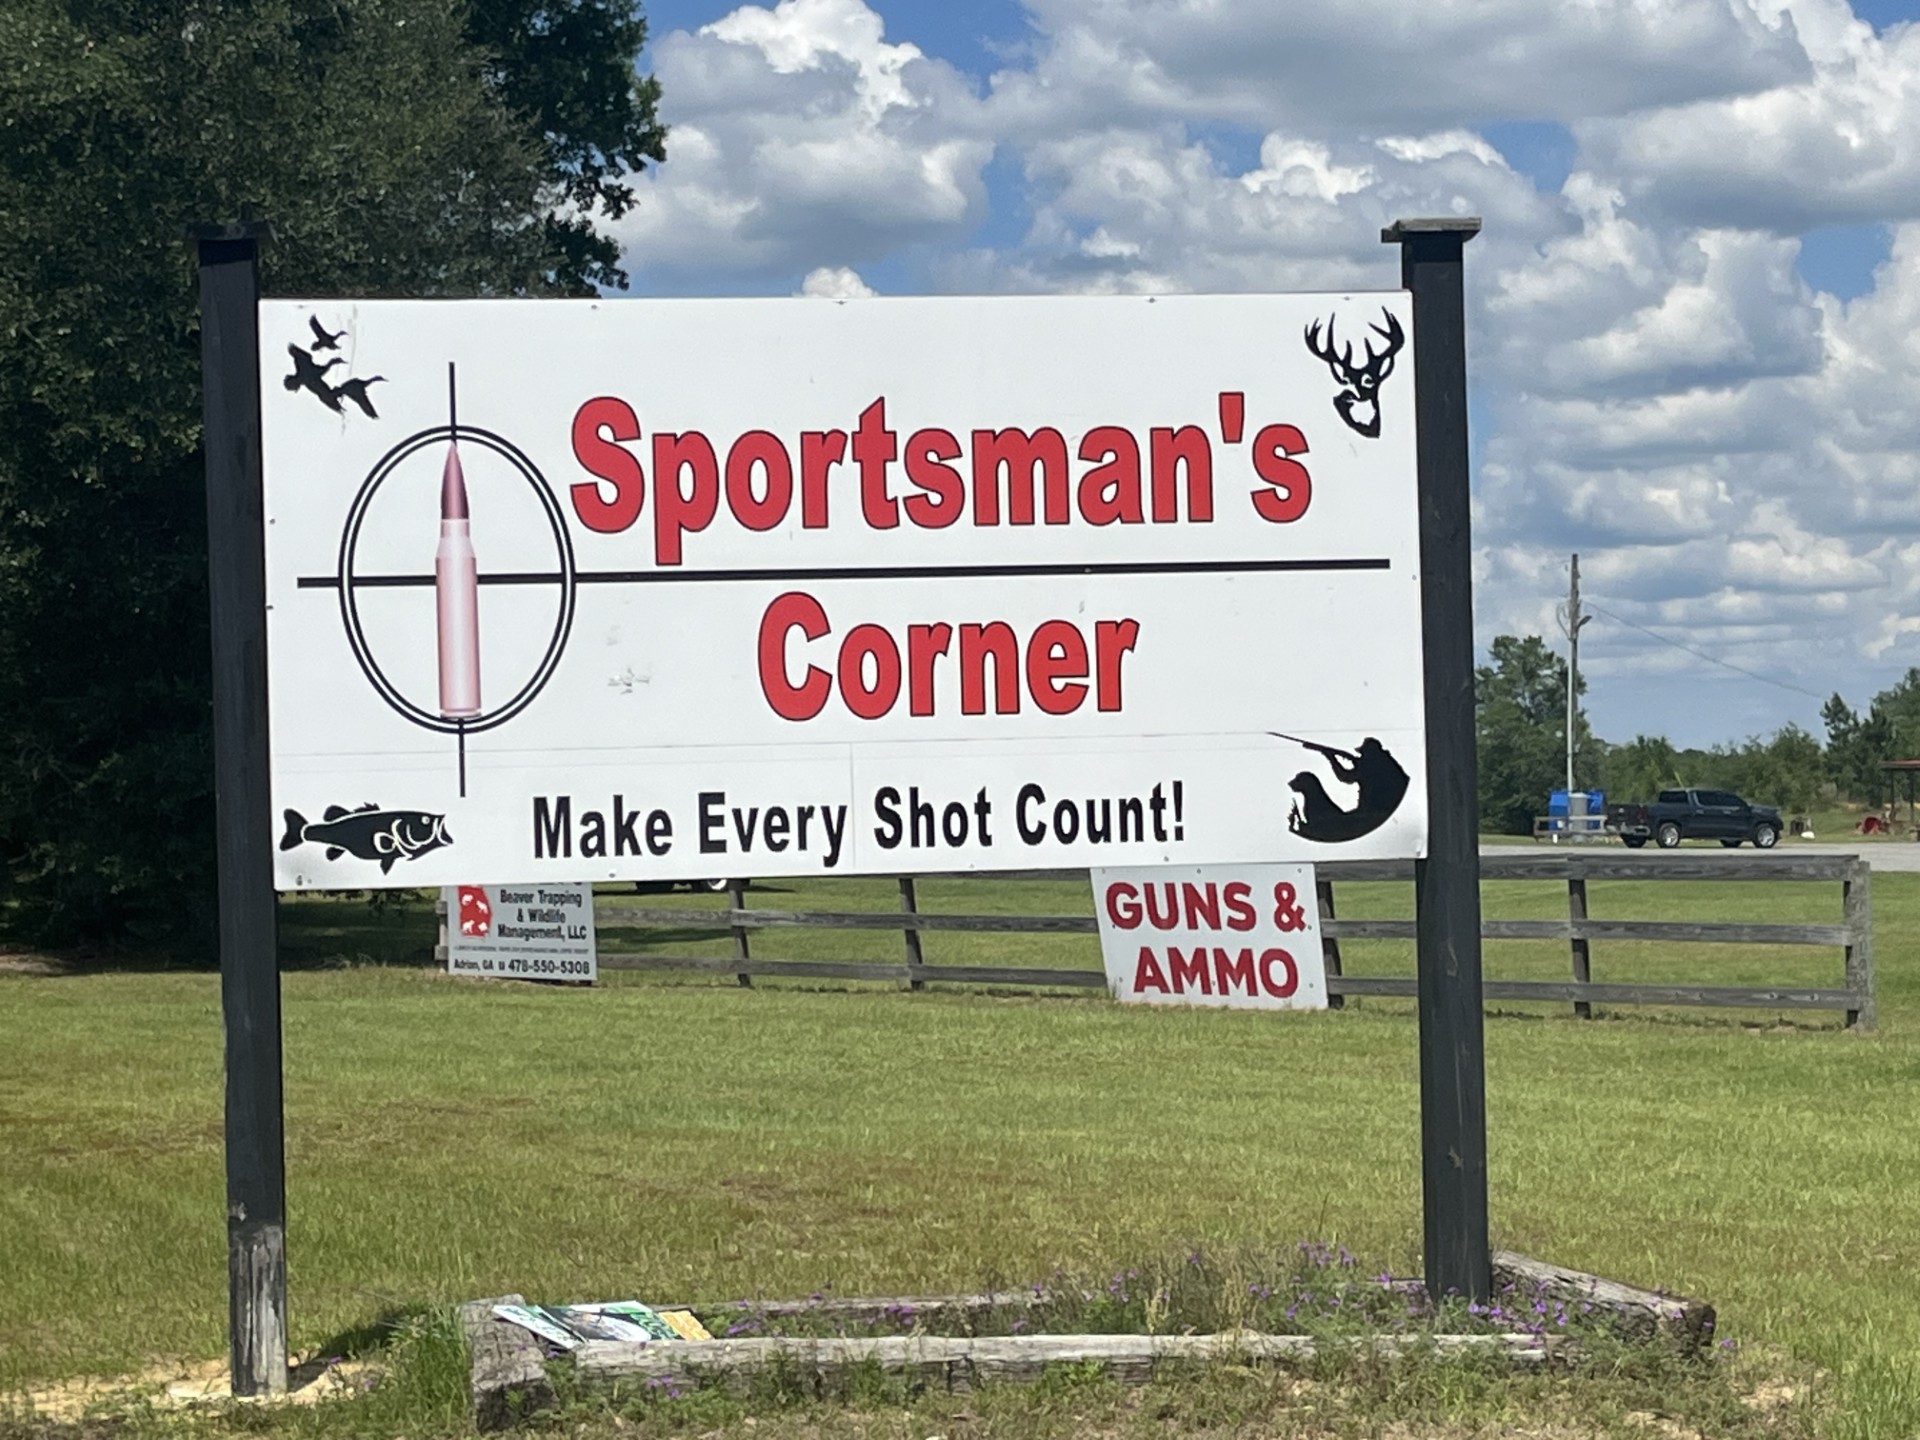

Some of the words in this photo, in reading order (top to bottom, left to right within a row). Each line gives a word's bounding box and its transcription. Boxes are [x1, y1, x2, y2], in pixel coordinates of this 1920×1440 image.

[570, 393, 1311, 566] Sportsman's
[758, 592, 1140, 721] Corner
[534, 795, 672, 858] Make
[699, 792, 847, 867] Every
[874, 787, 992, 849] Shot
[1016, 781, 1184, 846] Count!
[500, 889, 534, 903] Beaver
[538, 890, 582, 907] Trapping
[517, 909, 523, 922] &
[528, 909, 566, 923] Wildlife
[1106, 882, 1256, 931] GUNS
[1274, 881, 1306, 932] &
[498, 924, 565, 941] Management,
[568, 926, 587, 939] LLC
[482, 960, 493, 970] GA
[508, 959, 590, 974] 478-550-5308
[1134, 946, 1298, 998] AMMO
